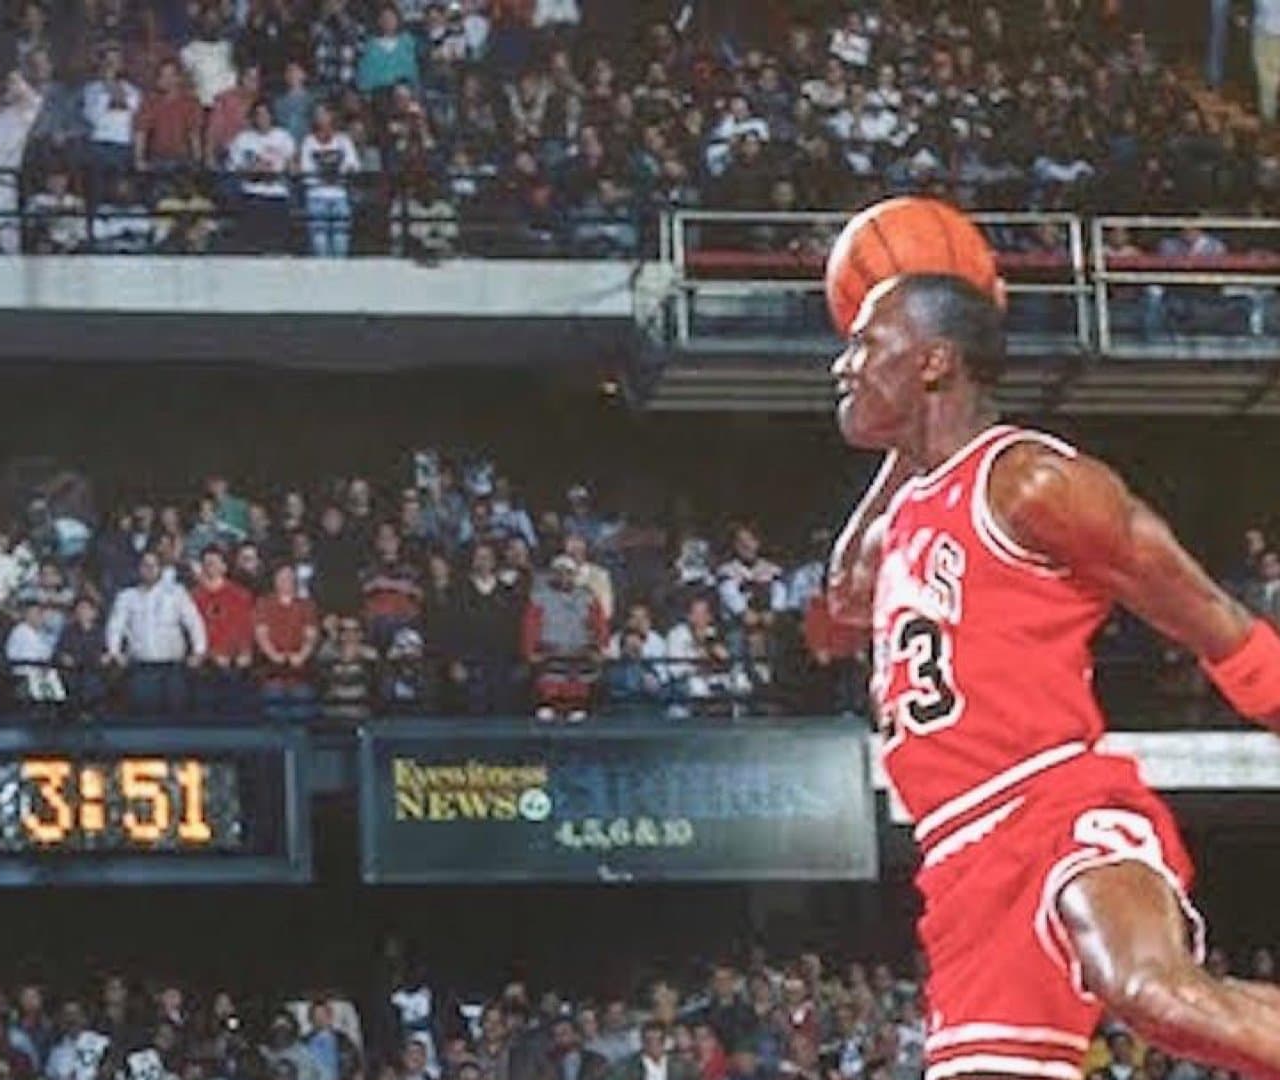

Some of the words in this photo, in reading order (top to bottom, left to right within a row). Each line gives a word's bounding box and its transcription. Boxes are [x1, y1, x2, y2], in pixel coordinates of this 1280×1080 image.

[392, 757, 549, 797] Eyewitness
[20, 757, 212, 842] 3:51
[394, 790, 518, 822] NEWS
